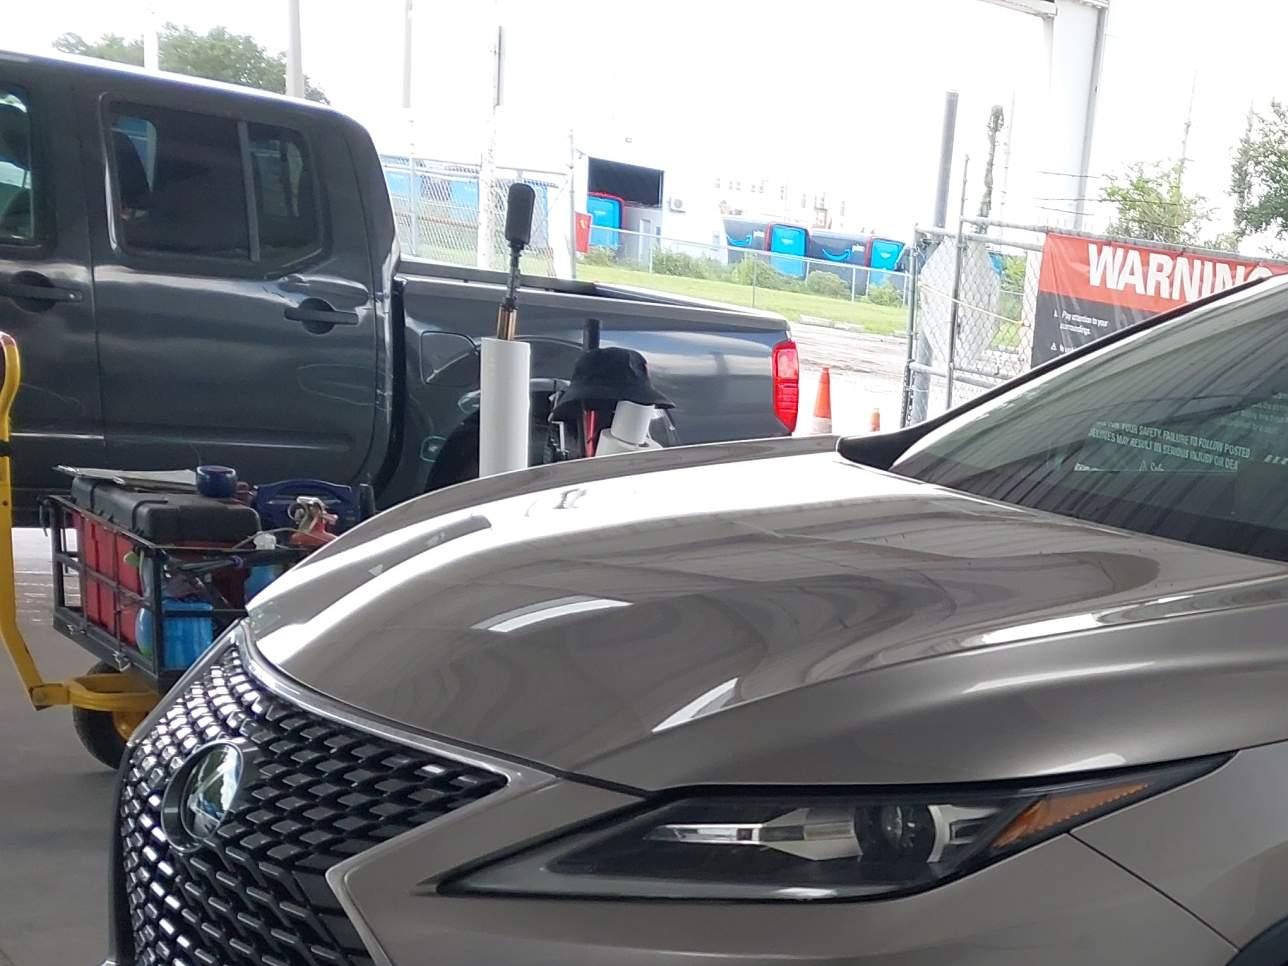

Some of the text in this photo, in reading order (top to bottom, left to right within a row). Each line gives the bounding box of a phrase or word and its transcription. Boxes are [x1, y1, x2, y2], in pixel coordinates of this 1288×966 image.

[1190, 435, 1198, 447] TO
[1198, 437, 1224, 452] FOLLOW
[1224, 443, 1251, 458] POSTED
